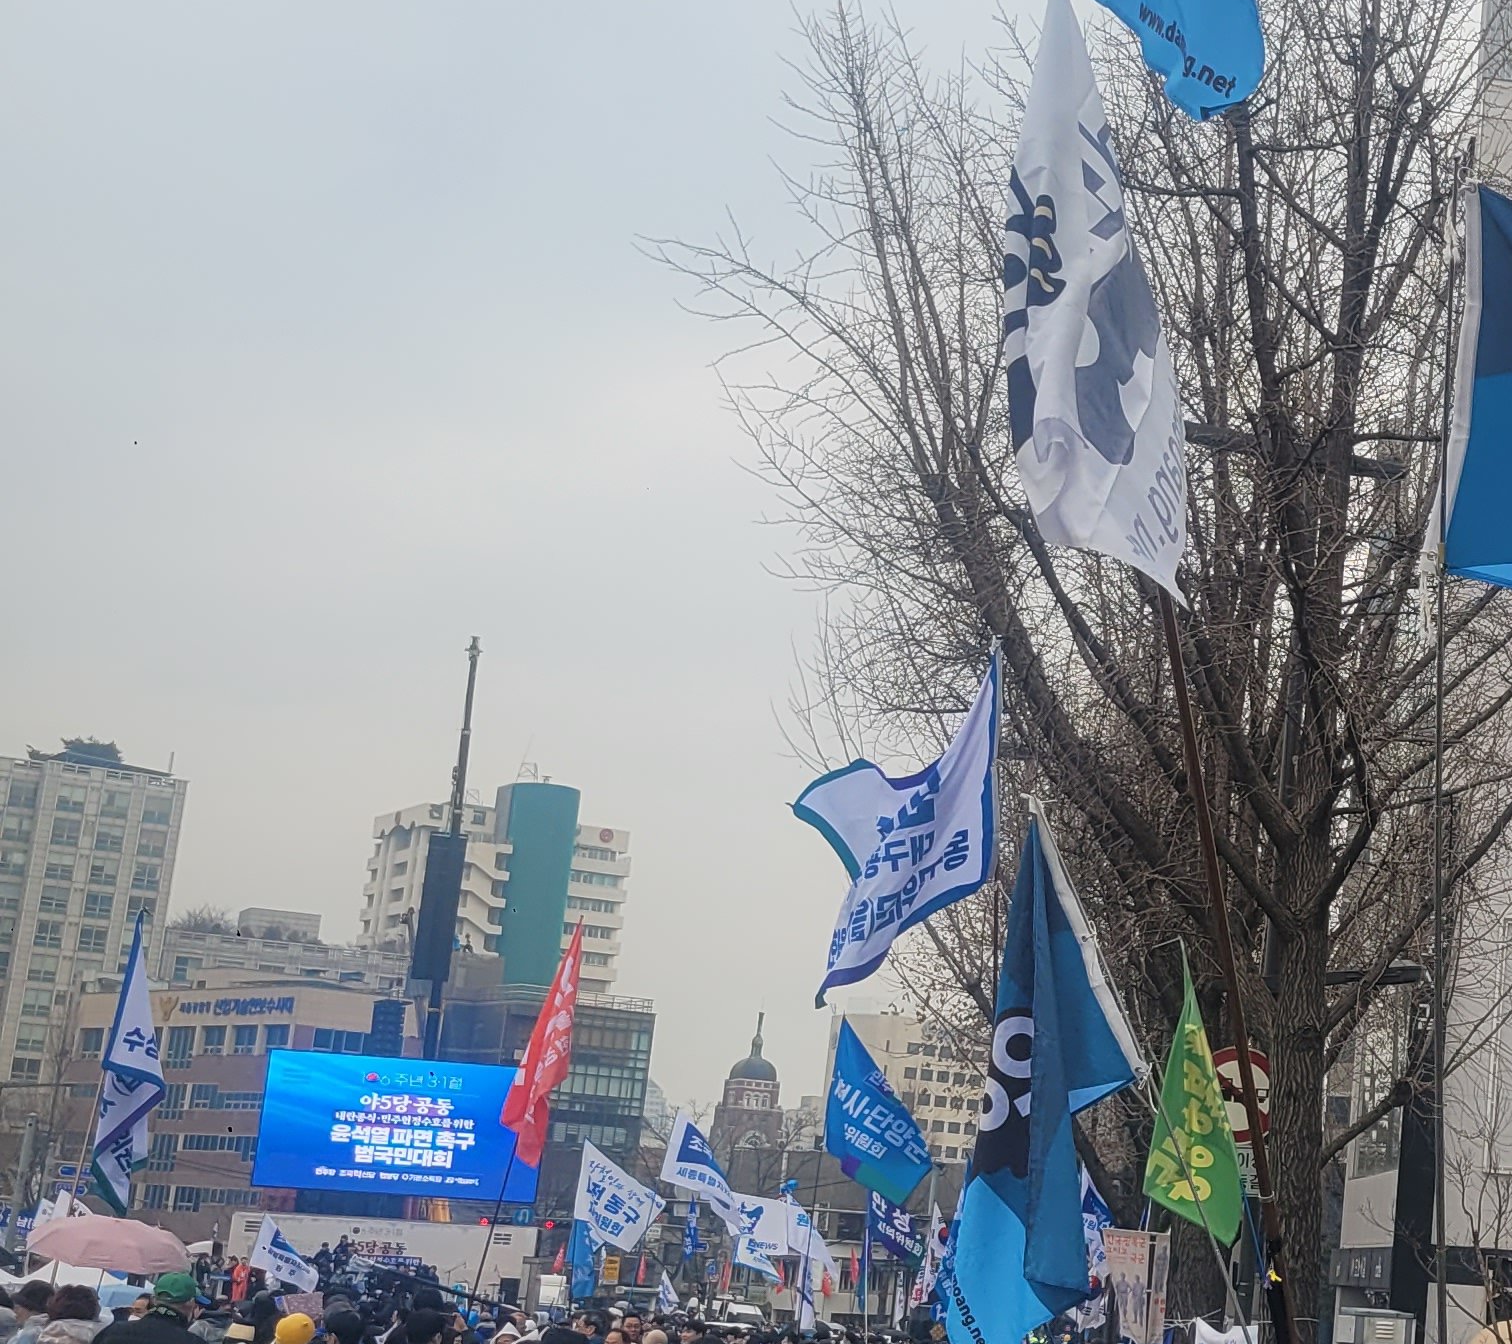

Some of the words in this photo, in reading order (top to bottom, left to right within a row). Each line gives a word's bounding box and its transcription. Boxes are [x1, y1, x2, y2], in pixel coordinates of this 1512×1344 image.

[360, 1092, 412, 1113] 야5당
[413, 1096, 454, 1116] 공동
[330, 1123, 390, 1144] 윤석열
[391, 1127, 434, 1148] 파면
[435, 1130, 476, 1151] 촉구
[354, 1145, 454, 1169] 범국민대회
